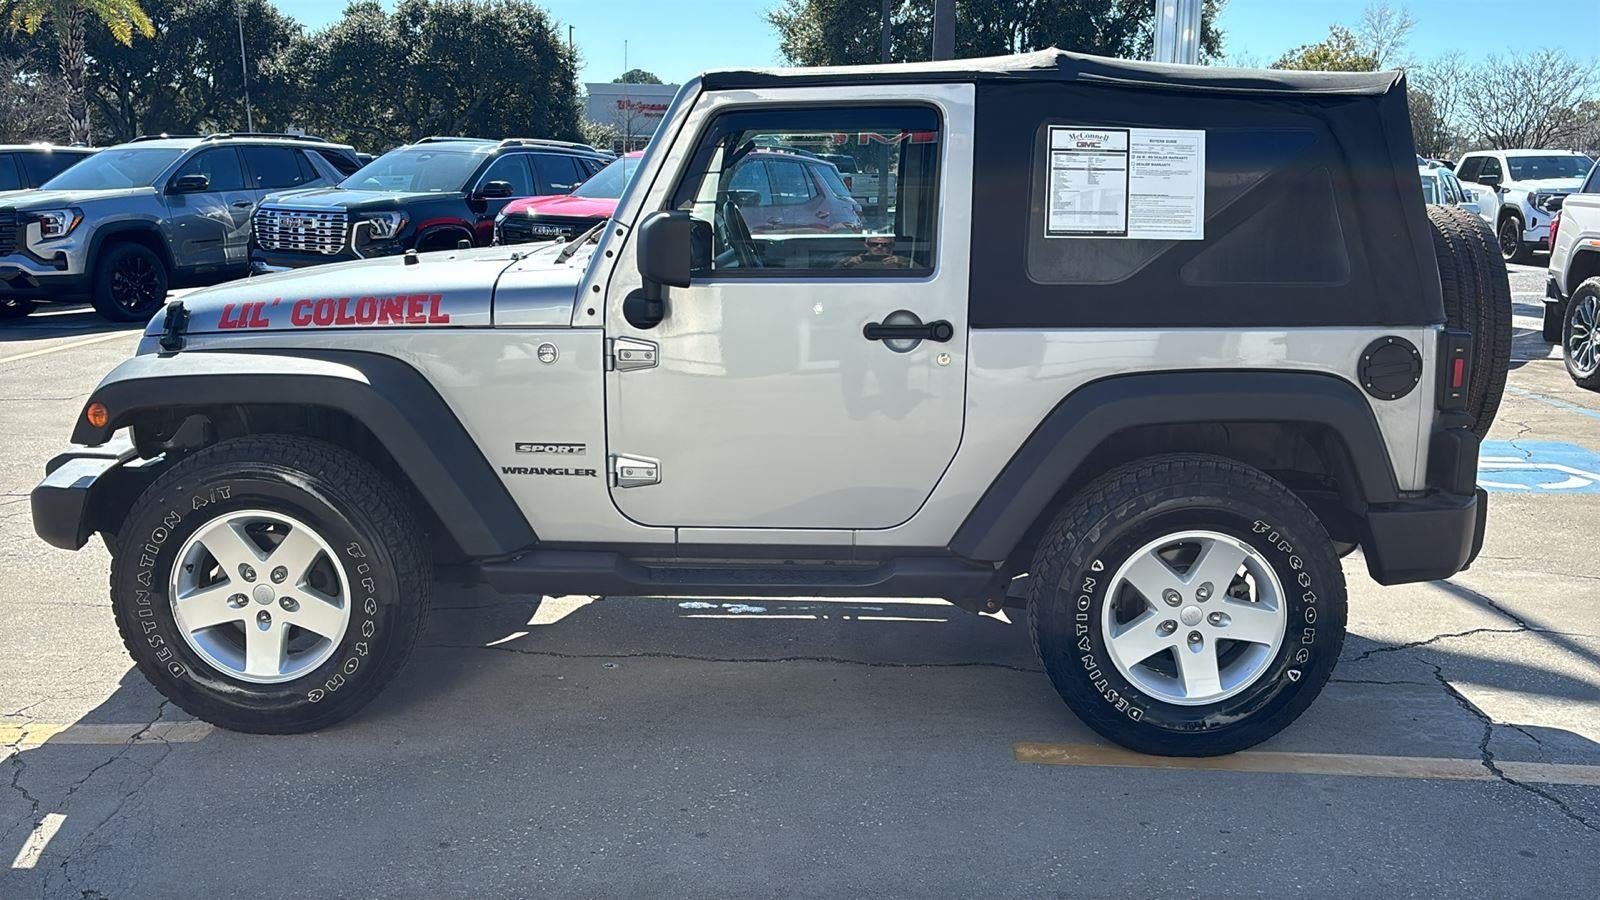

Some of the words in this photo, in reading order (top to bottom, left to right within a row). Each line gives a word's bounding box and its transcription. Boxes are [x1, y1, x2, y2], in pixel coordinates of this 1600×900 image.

[1069, 132, 1109, 141] McConnell
[532, 223, 572, 236] GMC
[217, 297, 281, 329] LIL'
[290, 293, 451, 327] COLONEL
[517, 443, 586, 454] SPORT
[501, 466, 598, 478] WRANGLER
[136, 510, 186, 679] DESTINATION
[192, 485, 231, 510] A/T
[1252, 519, 1317, 664] Firestone
[307, 542, 377, 703] Firestone
[1075, 576, 1144, 722] DESTINATION
